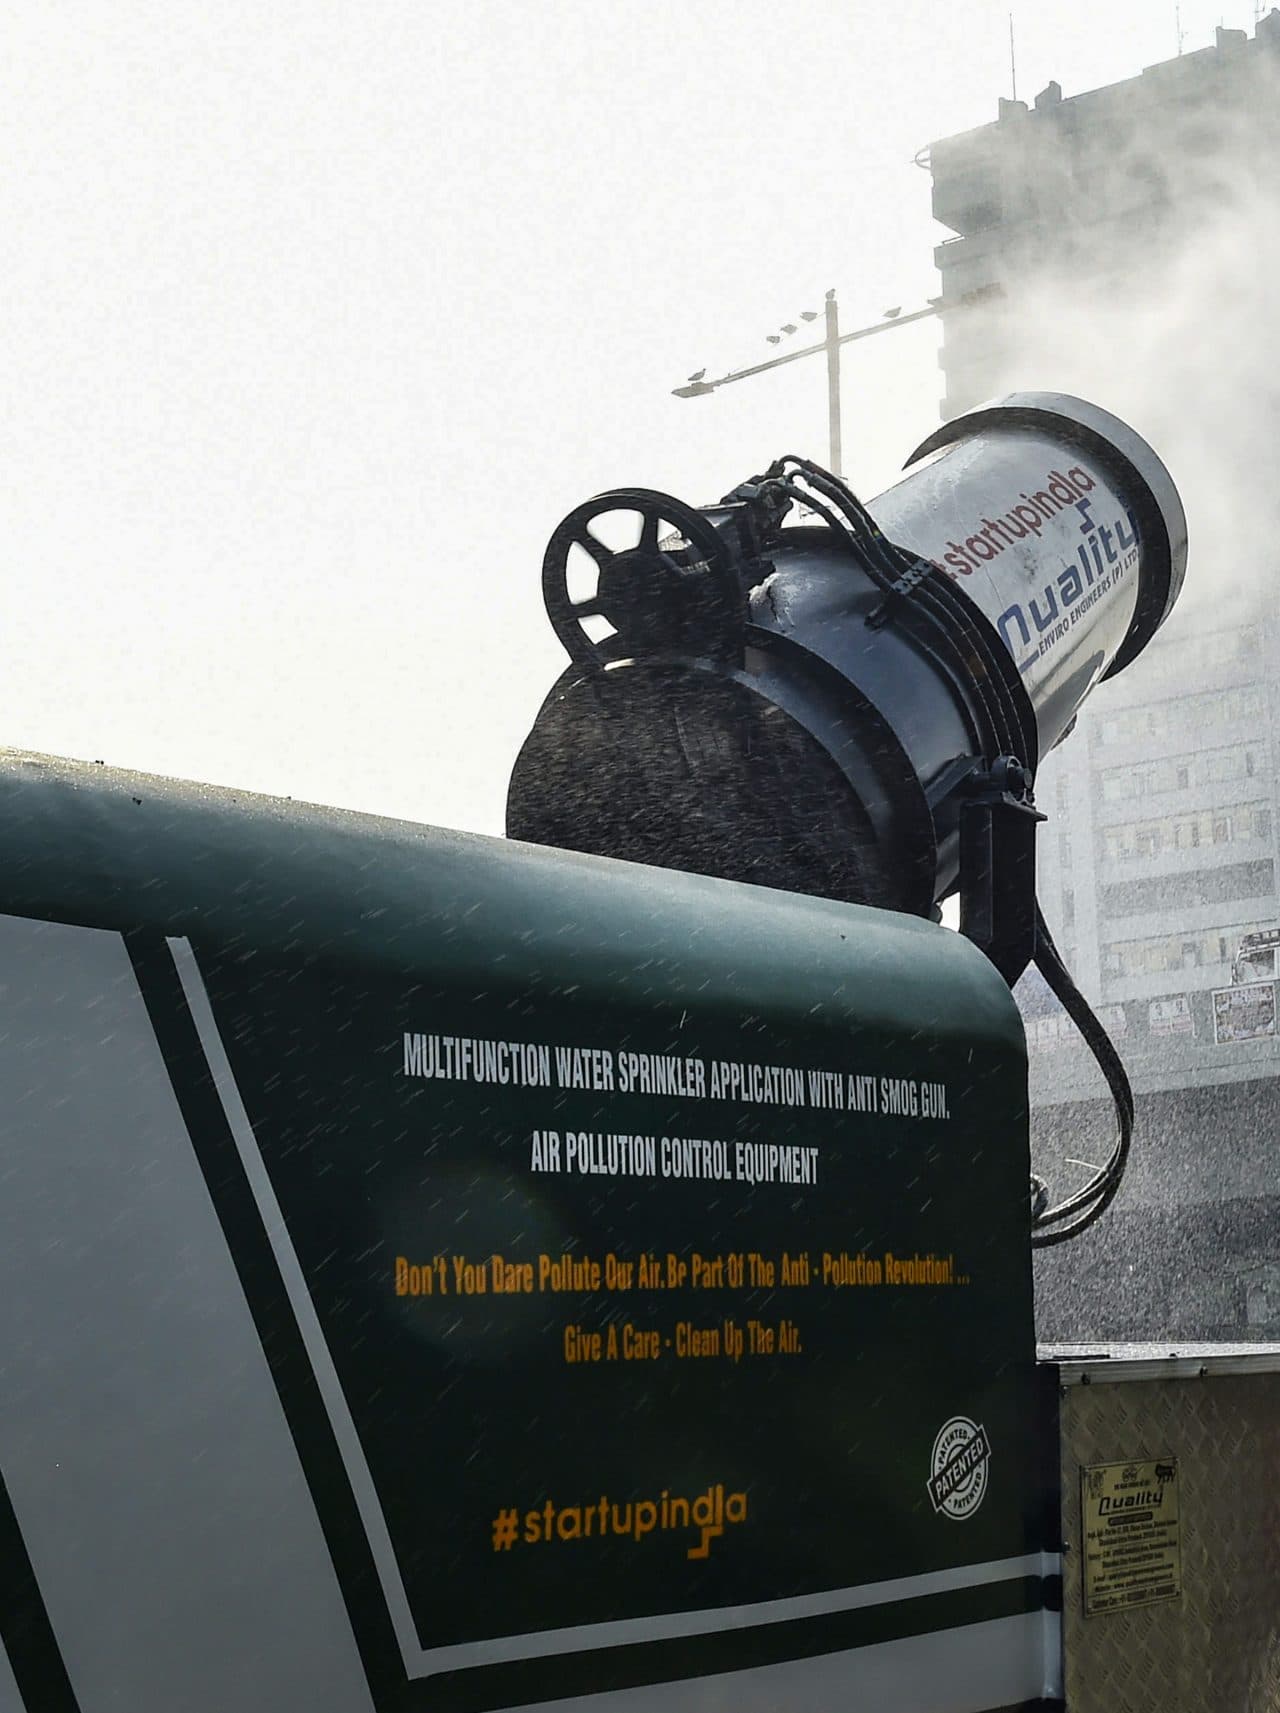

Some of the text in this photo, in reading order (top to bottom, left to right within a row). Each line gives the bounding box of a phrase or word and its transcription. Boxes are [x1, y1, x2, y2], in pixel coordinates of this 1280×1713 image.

[1039, 618, 1069, 656] ENVIRO
[1070, 576, 1112, 625] ENGINEERS
[1112, 562, 1123, 584] (P)
[404, 1032, 950, 1119] MULTIFUNCTION WATER SPRINKLER APPLICATION WITH ANTI SMOG GUN.
[530, 1130, 819, 1185] AIR POLLUTION CONTROL EQUIPMENT
[395, 1256, 448, 1297] Don't
[452, 1257, 487, 1295] You
[491, 1255, 534, 1294] Dare
[538, 1253, 601, 1292] Pollute
[605, 1253, 634, 1291] Our
[691, 1253, 724, 1289] Part
[727, 1253, 745, 1288] Of
[748, 1253, 775, 1287] The
[780, 1252, 810, 1286] Anti
[822, 1252, 882, 1286] Pollution
[884, 1252, 953, 1286] Revolution!
[564, 1325, 602, 1362] Give
[606, 1323, 618, 1360] A
[623, 1323, 660, 1360] Care
[675, 1322, 720, 1357] Clean
[724, 1321, 744, 1361] Up
[747, 1320, 775, 1355] The
[779, 1320, 803, 1353] Air.
[935, 1437, 983, 1500] PATENTED
